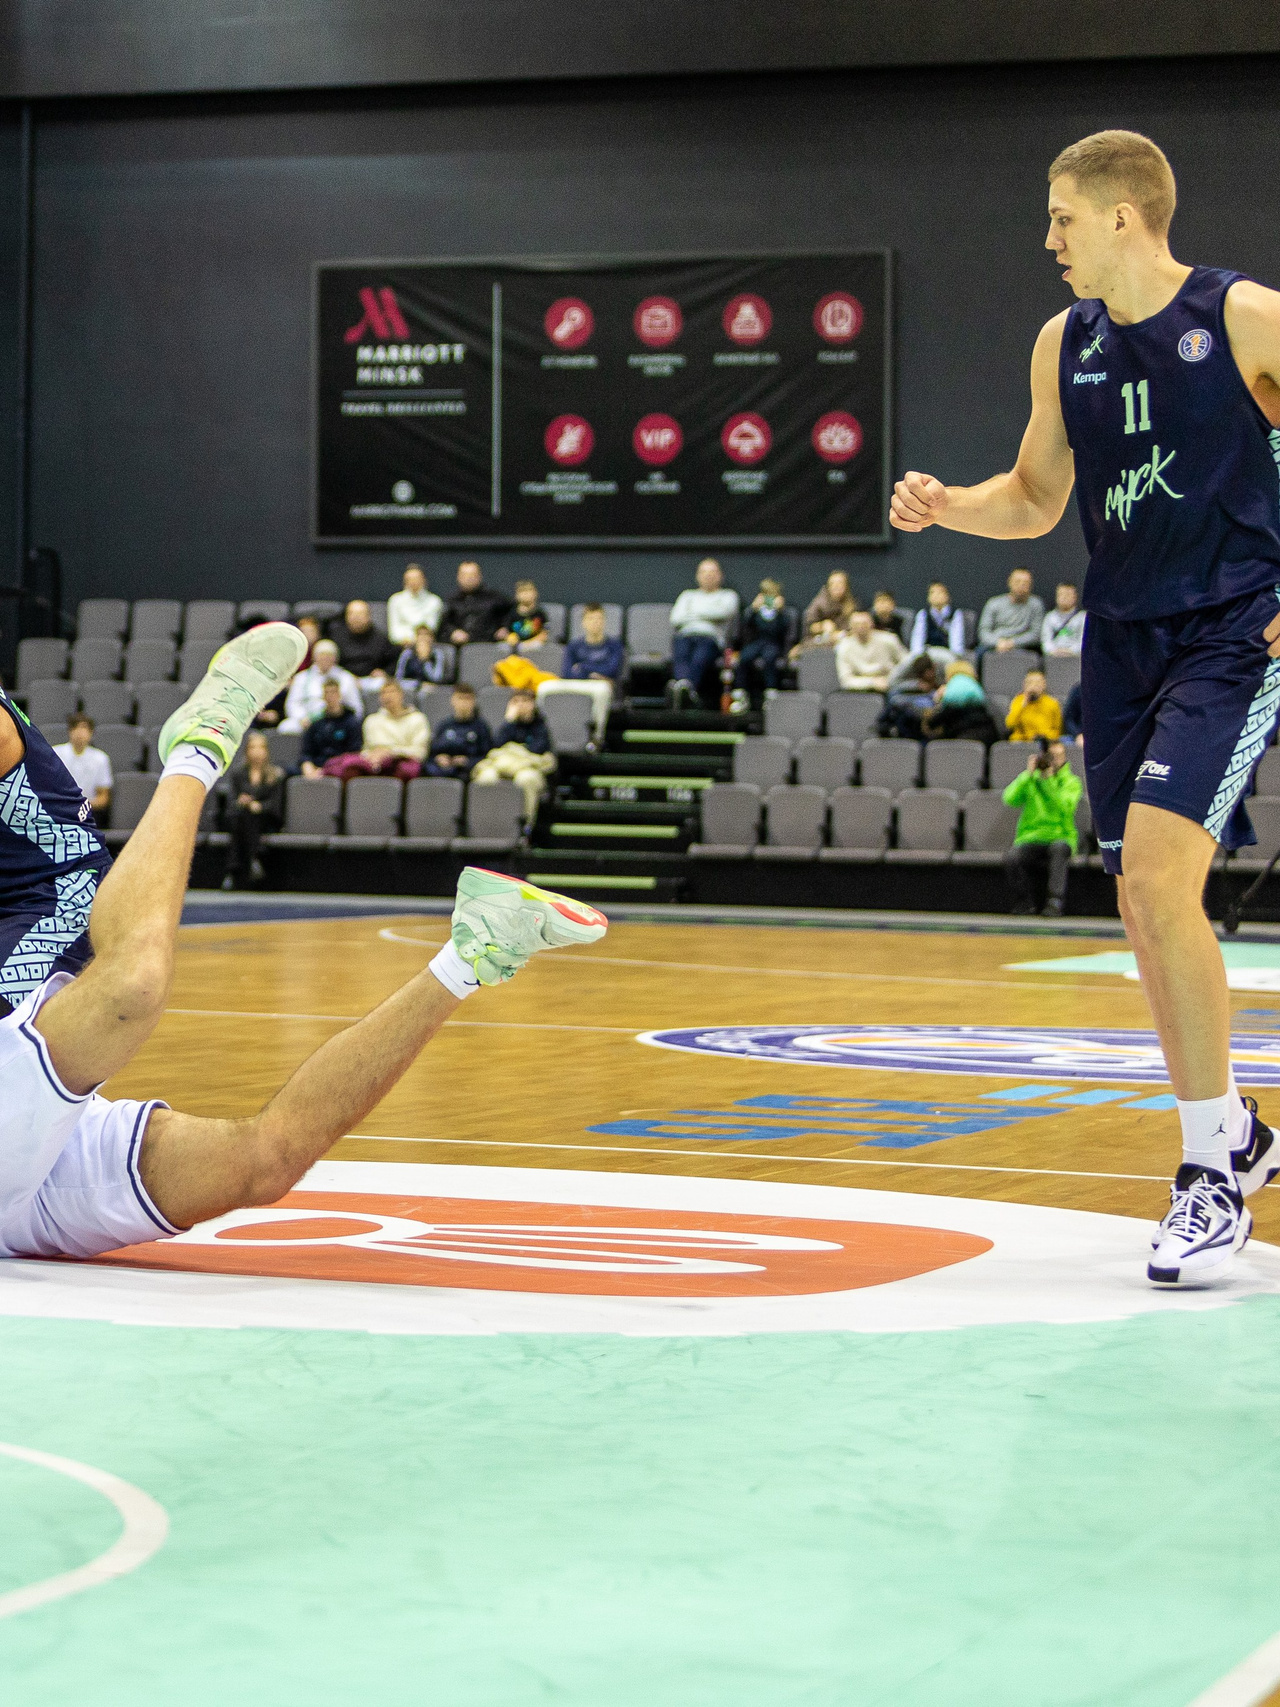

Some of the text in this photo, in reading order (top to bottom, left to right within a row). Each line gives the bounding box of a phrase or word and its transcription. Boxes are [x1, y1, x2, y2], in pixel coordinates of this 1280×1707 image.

[356, 344, 465, 365] MARRIOTT
[356, 365, 423, 386] MINSK
[1073, 371, 1107, 385] Kempa
[1121, 379, 1151, 434] 11
[640, 429, 676, 450] VIP
